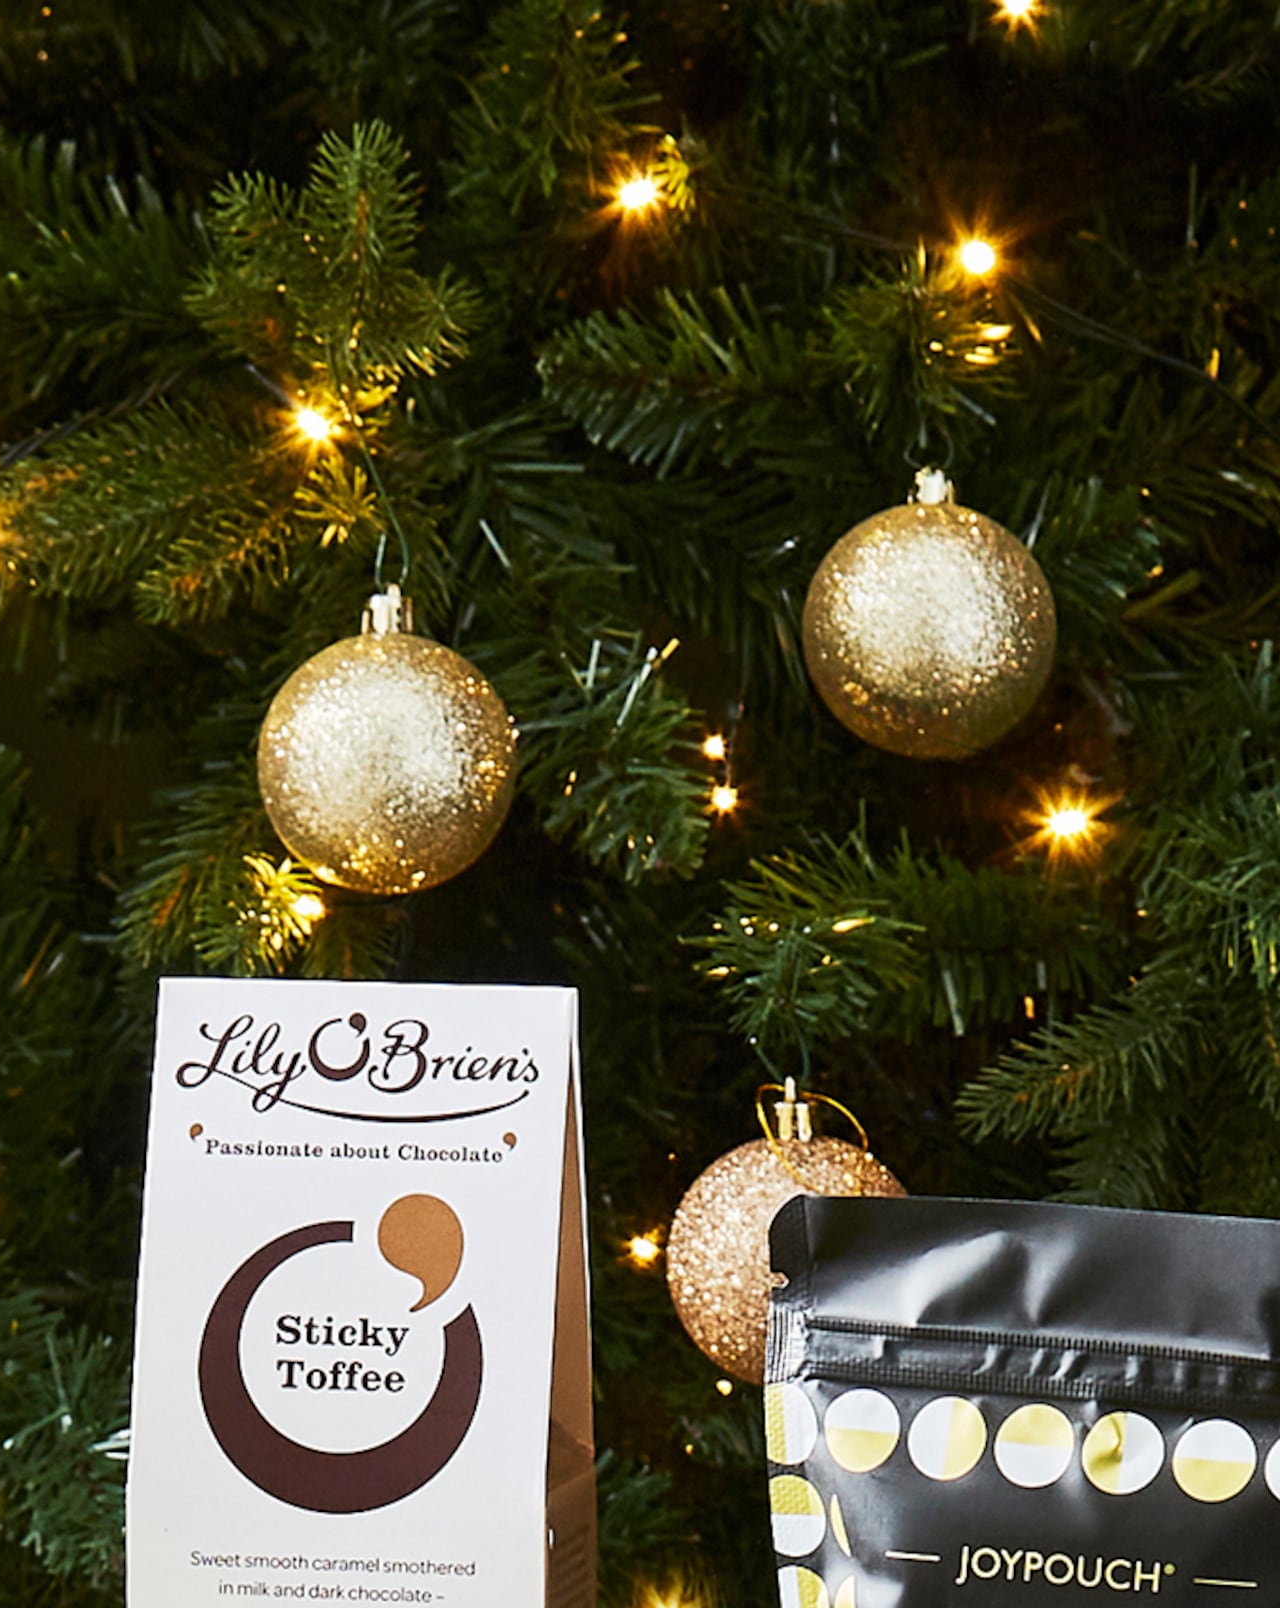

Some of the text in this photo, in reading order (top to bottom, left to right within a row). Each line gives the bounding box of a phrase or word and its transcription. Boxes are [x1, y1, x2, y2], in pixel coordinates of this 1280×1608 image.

[176, 1014, 307, 1112] Lily
[330, 1142, 390, 1160] about
[275, 1314, 410, 1356] Sticky
[276, 1359, 406, 1393] Toffee
[190, 1550, 476, 1577] Sweet smooth caramel smothered
[219, 1580, 233, 1595] in
[237, 1581, 270, 1598] milk
[274, 1584, 305, 1599] and
[308, 1585, 345, 1600] dark
[348, 1585, 433, 1604] chocolate
